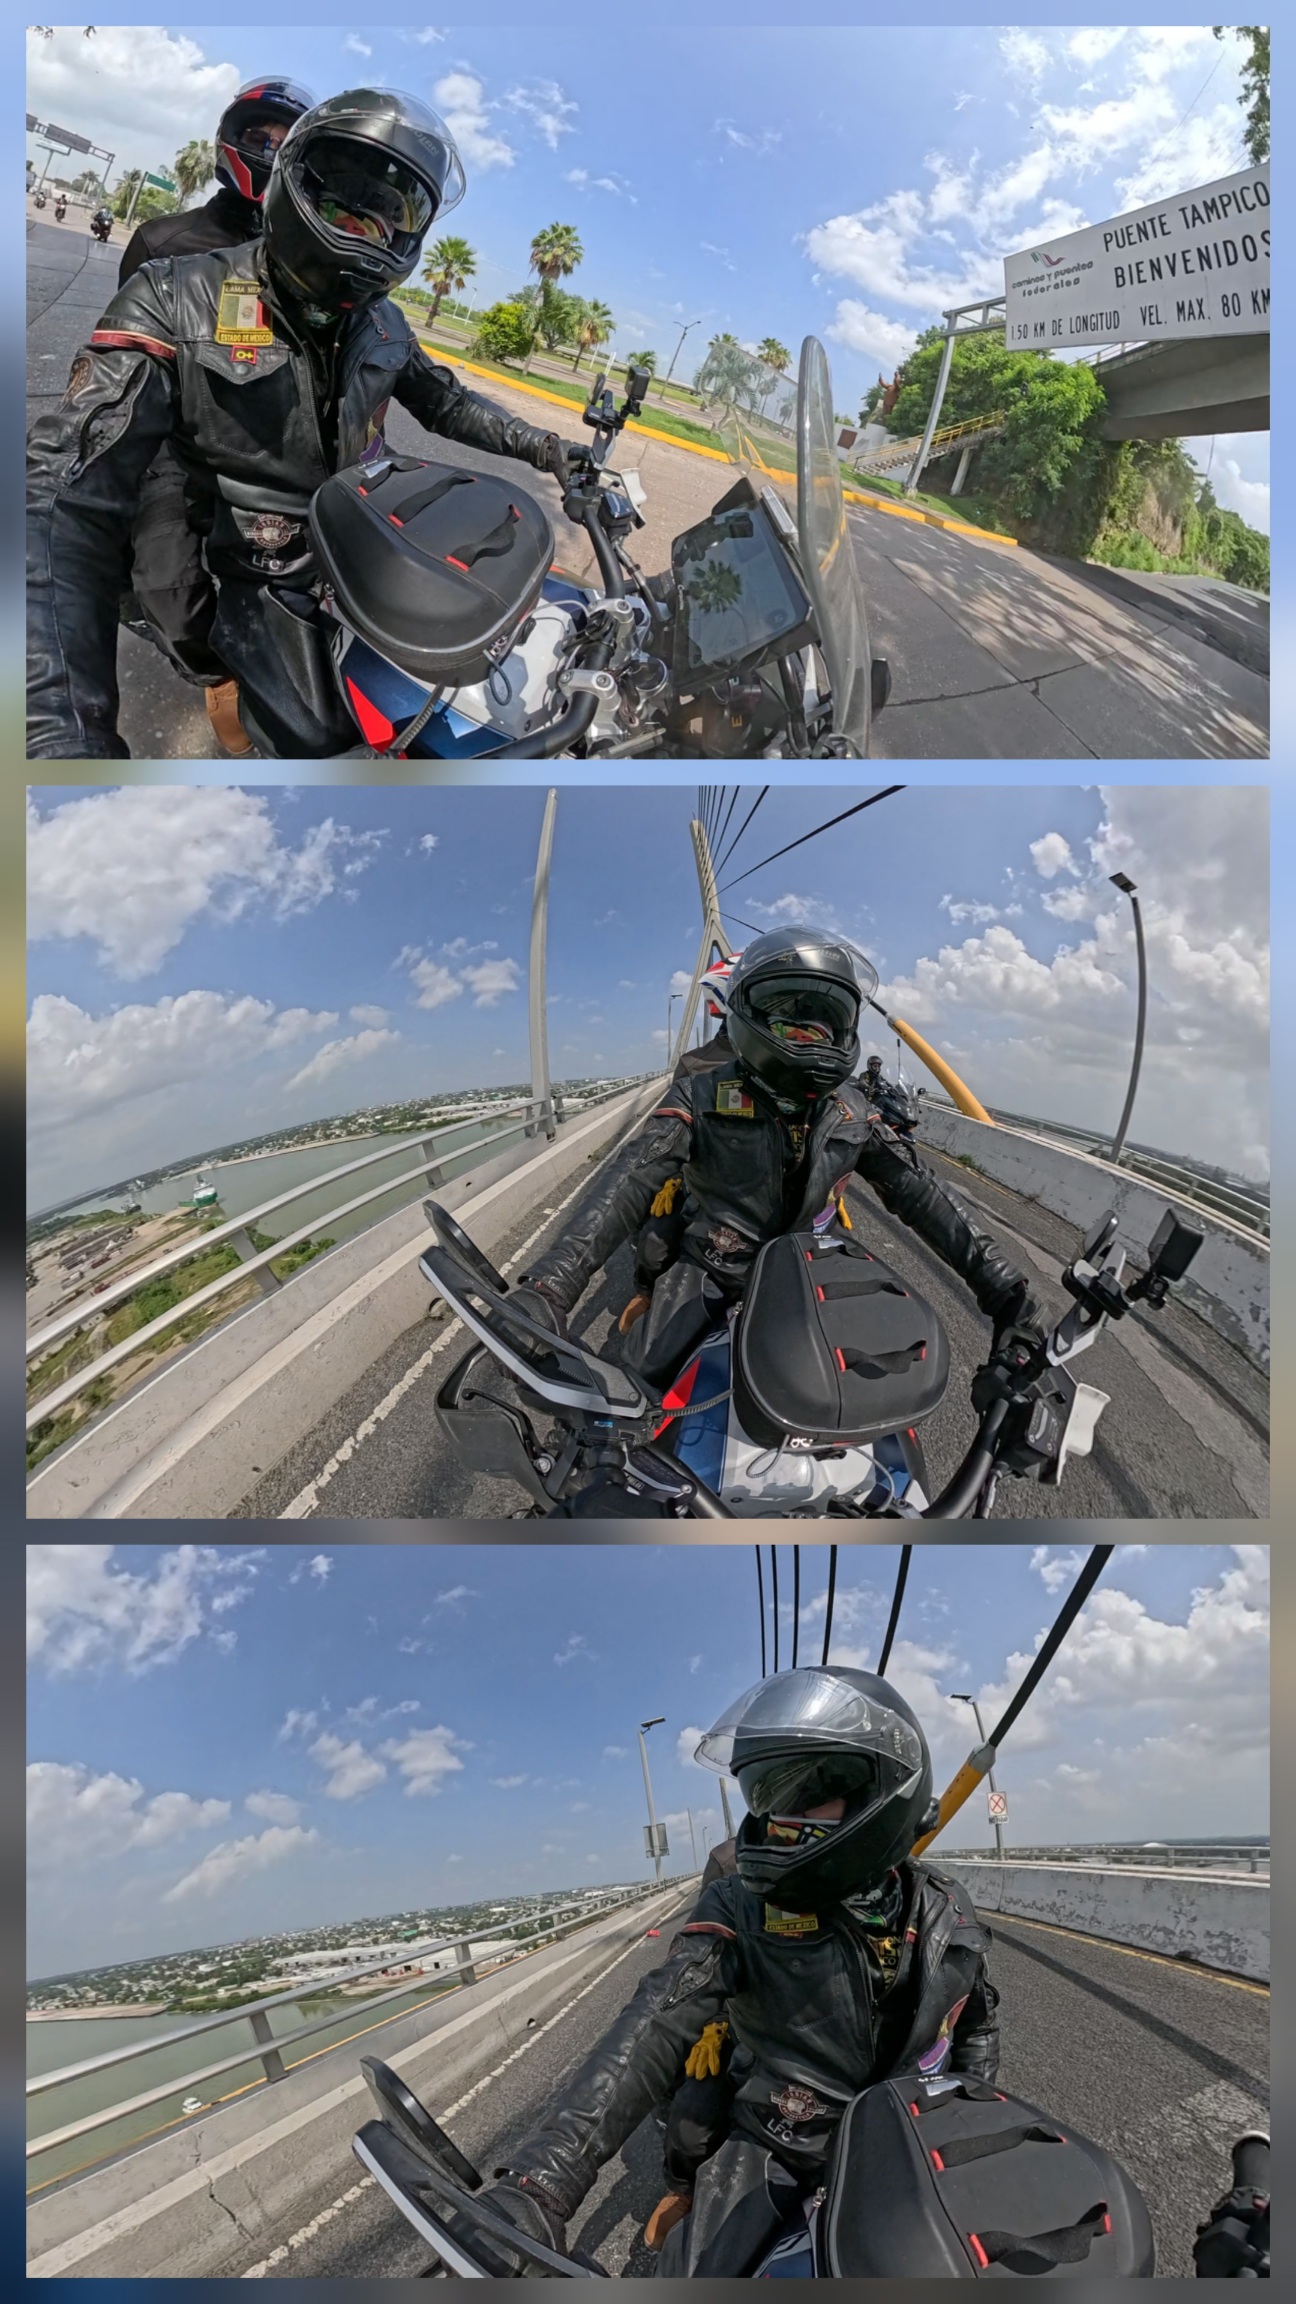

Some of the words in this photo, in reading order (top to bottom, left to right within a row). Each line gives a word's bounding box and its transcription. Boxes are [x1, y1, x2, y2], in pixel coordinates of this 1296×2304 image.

[1103, 213, 1172, 252] PUENTE
[1178, 181, 1270, 230] TAMPICO
[1011, 273, 1045, 289] caminos
[1054, 260, 1094, 279] puentes
[1114, 229, 1270, 288] BIENVENIDOS
[1011, 323, 1028, 341] 1.50
[1033, 321, 1045, 338] KM
[1052, 319, 1063, 336] DE
[1069, 310, 1120, 334] LONGITUD
[1140, 305, 1168, 327] VEL.
[1176, 298, 1212, 323] MAX.
[1221, 292, 1241, 317] 80
